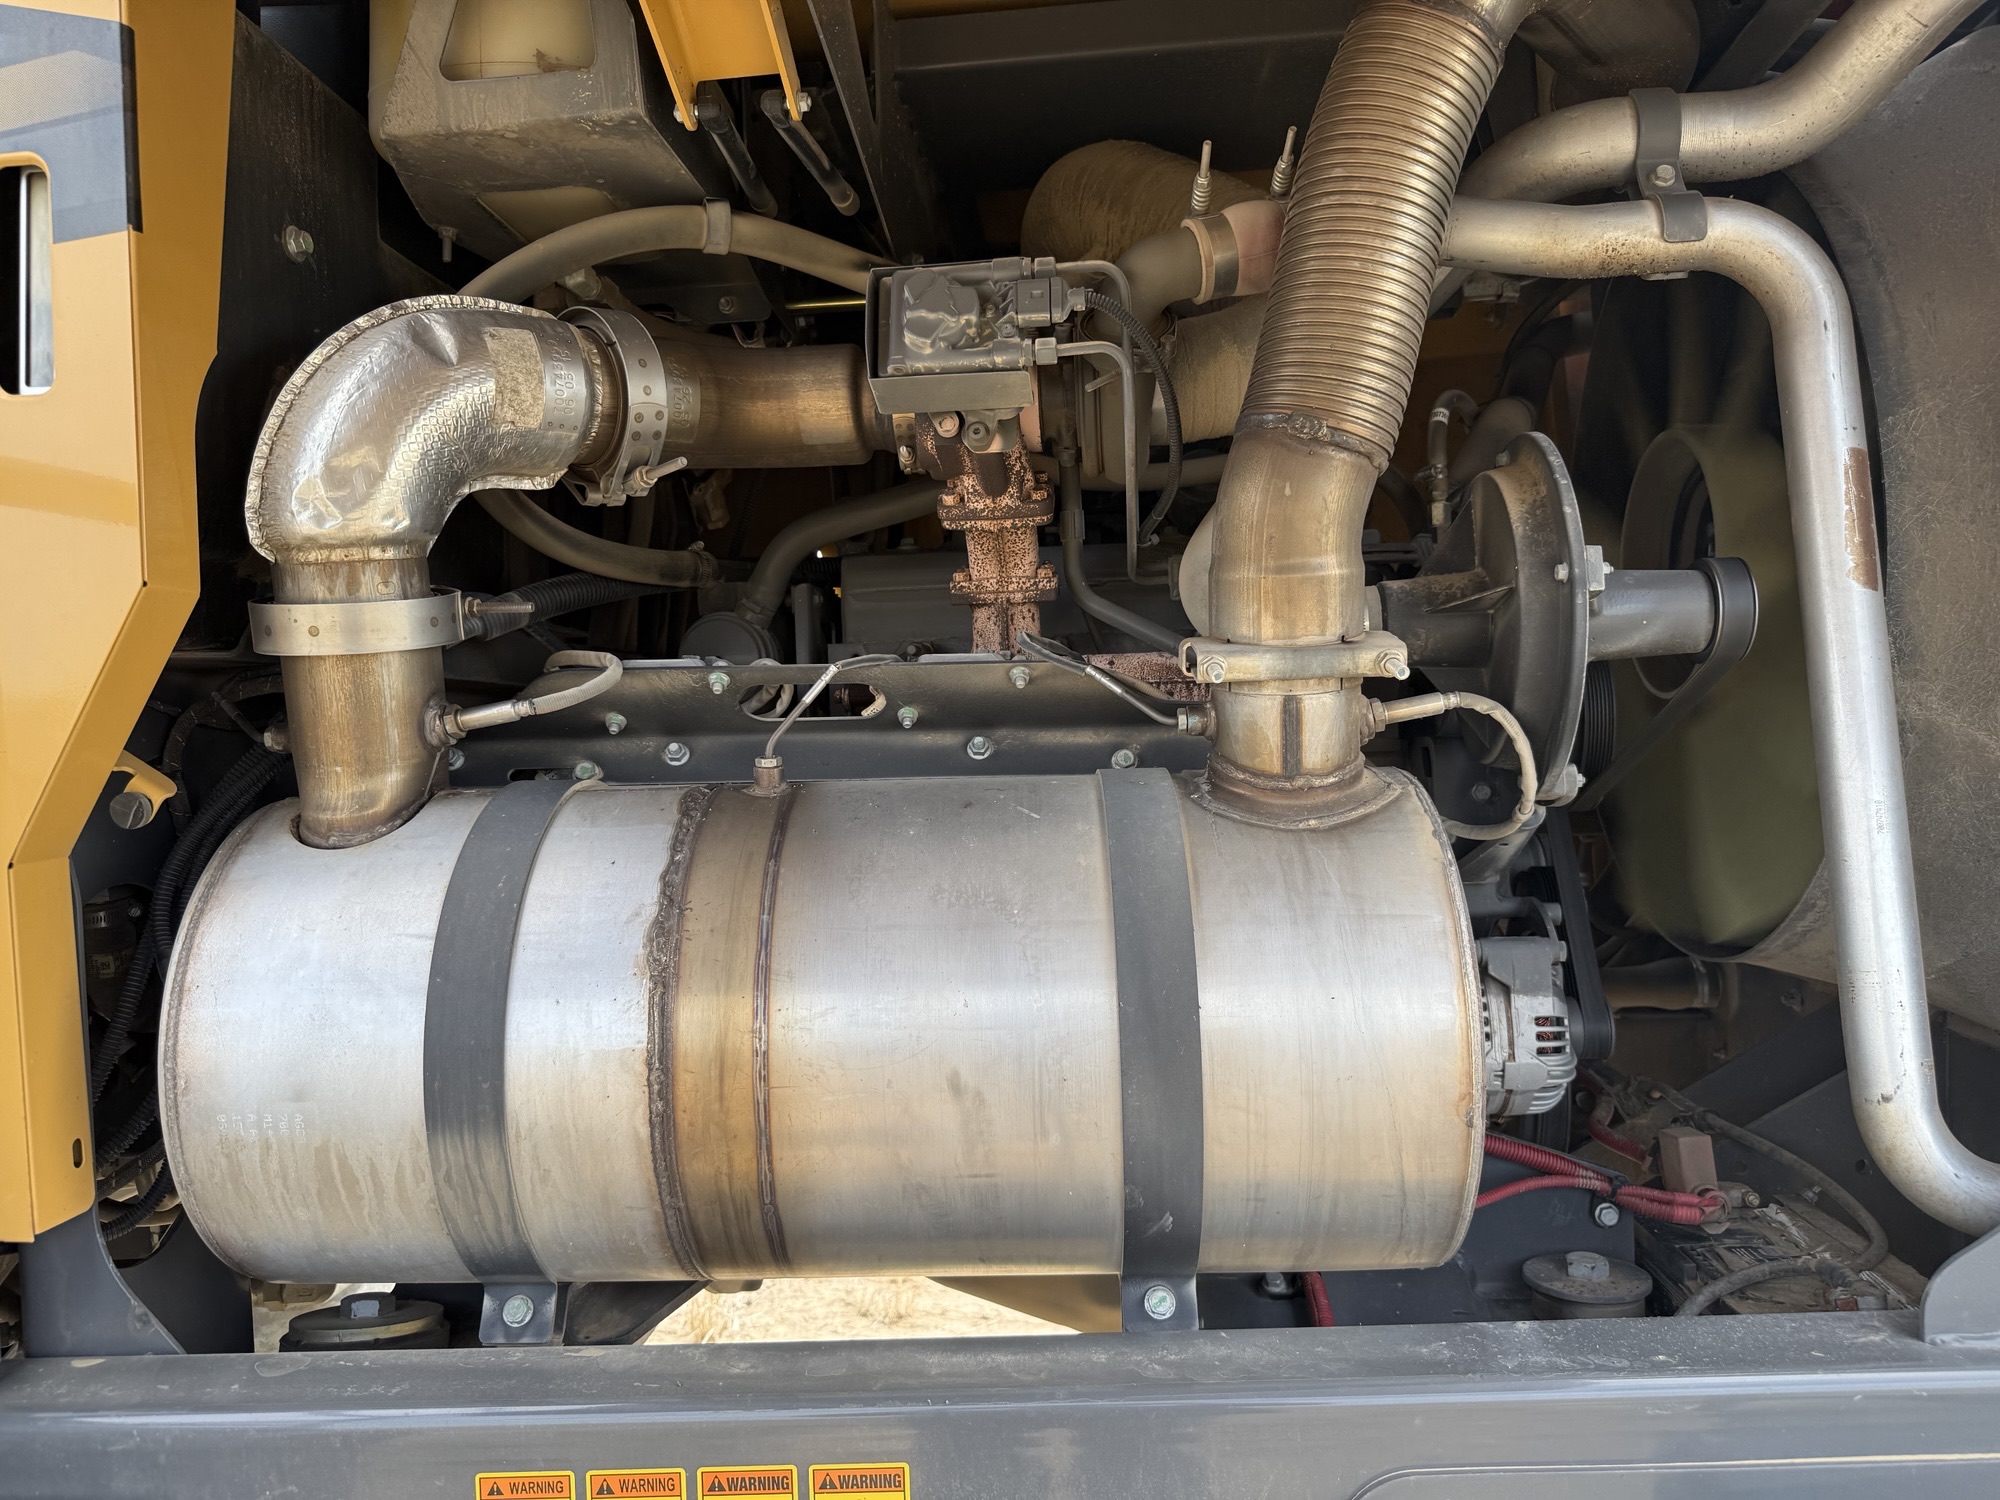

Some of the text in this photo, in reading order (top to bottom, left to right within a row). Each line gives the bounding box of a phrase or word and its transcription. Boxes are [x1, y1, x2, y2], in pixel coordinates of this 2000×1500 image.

[682, 387, 692, 403] 26
[563, 399, 575, 415] 06
[509, 1480, 564, 1495] WARNING
[618, 1477, 675, 1493] WARNING
[726, 1475, 790, 1491] WARNING
[838, 1473, 902, 1490] WARNING
